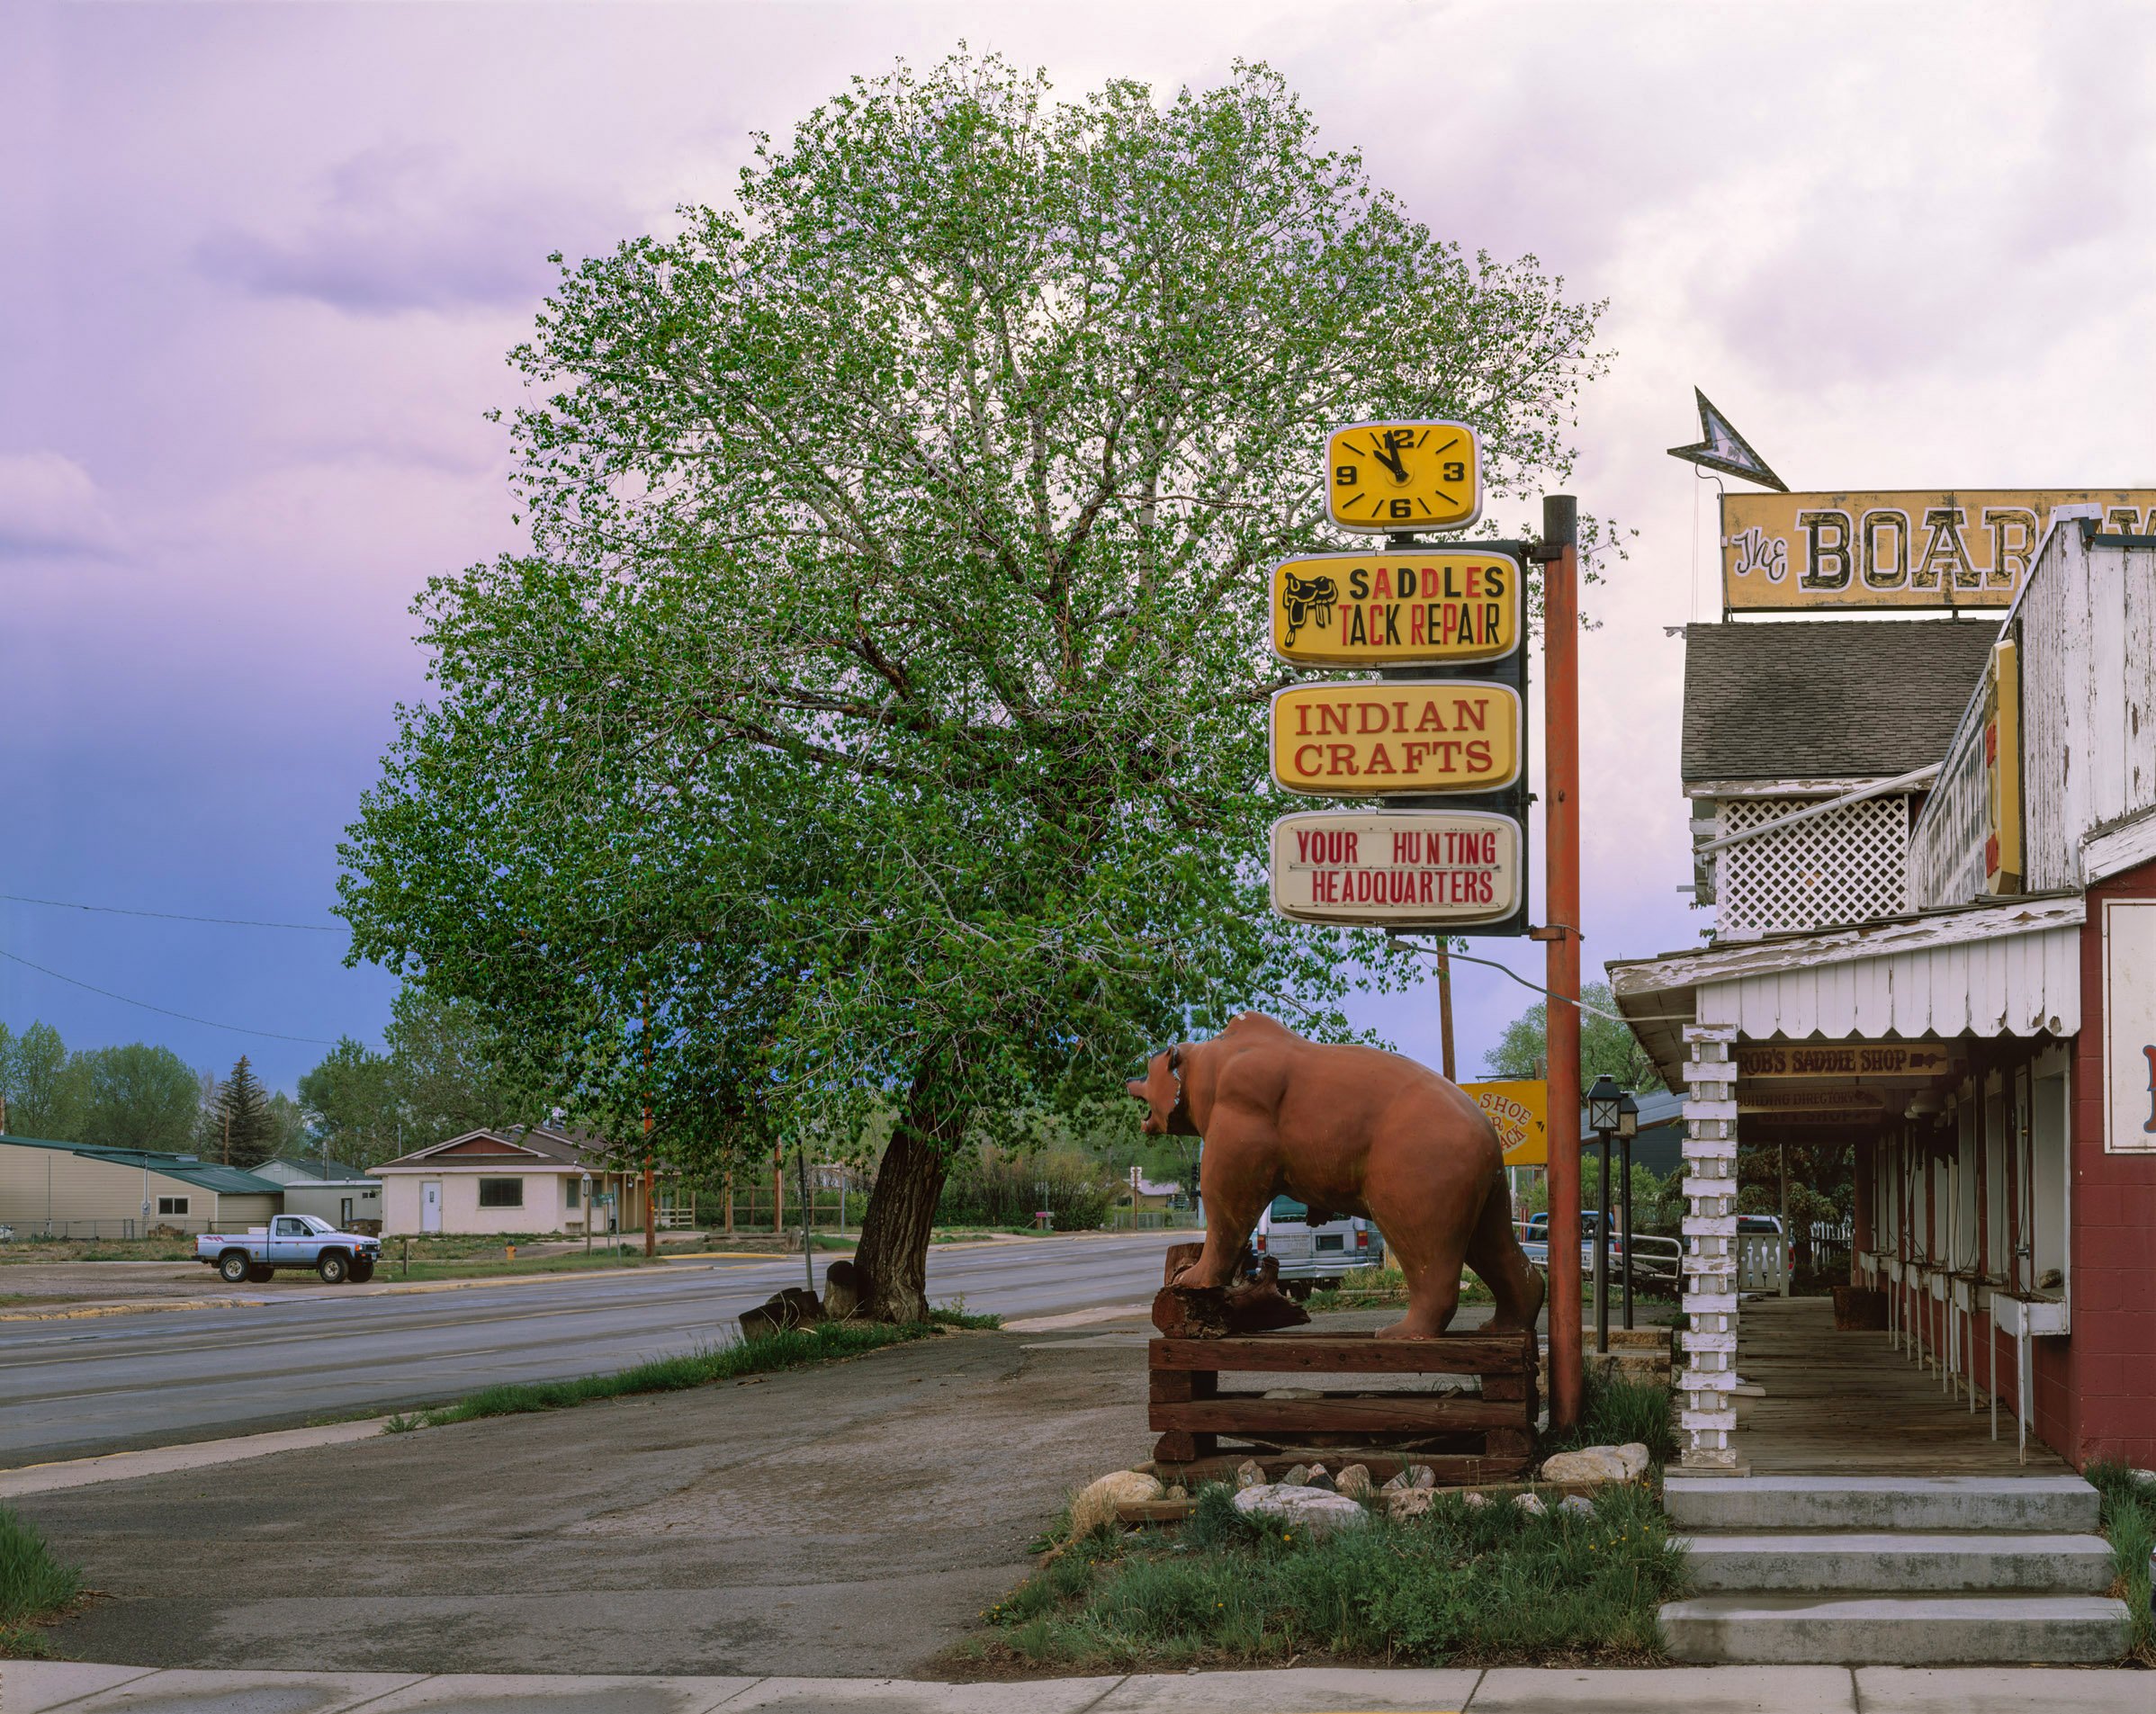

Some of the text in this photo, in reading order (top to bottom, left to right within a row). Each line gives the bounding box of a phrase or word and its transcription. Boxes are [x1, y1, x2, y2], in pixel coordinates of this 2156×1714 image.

[1383, 428, 1414, 449] 12
[1336, 462, 1465, 486] 9 3
[1390, 498, 1411, 518] 6
[1729, 526, 1789, 584] The
[1349, 566, 1505, 599] SADDLES
[1338, 602, 1500, 646] TACK REPAIR
[1295, 699, 1489, 735] INDIAN
[1294, 740, 1493, 776] CRAFTS
[1297, 830, 1496, 865] YOUR HUNTING
[1311, 870, 1494, 904] HEADQUARTERS
[1738, 1048, 1908, 1076] ROB'S SADDLE SHOP
[1480, 1093, 1532, 1125] SHOE
[1737, 1090, 1855, 1108] BUILDING DIRECTORY
[1499, 1124, 1527, 1151] ACK
